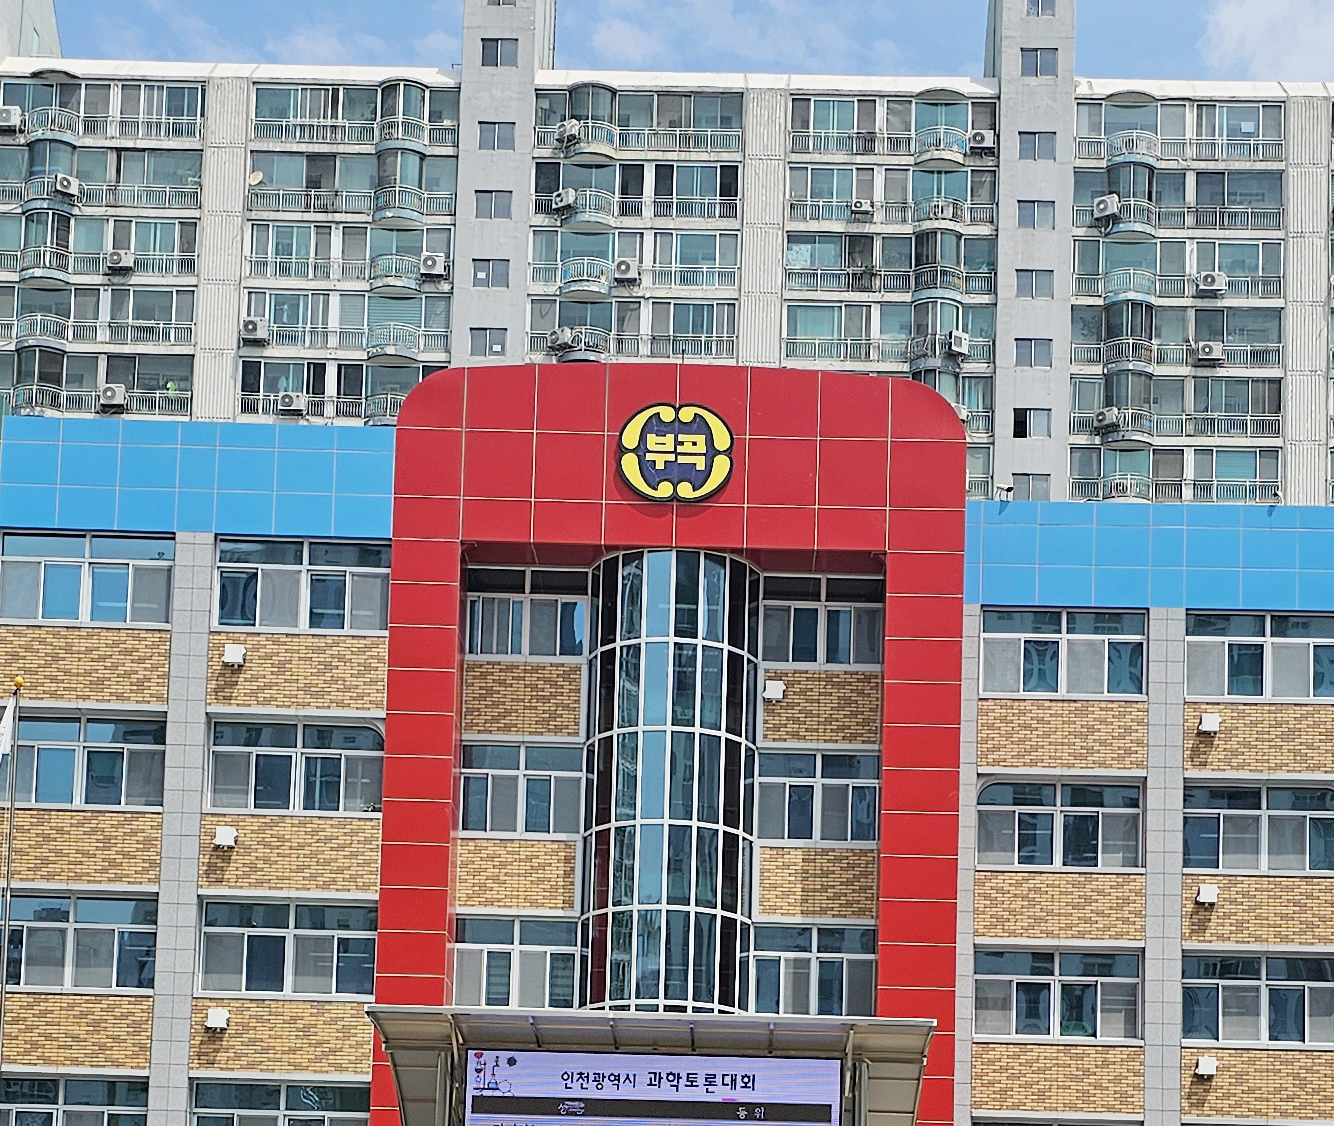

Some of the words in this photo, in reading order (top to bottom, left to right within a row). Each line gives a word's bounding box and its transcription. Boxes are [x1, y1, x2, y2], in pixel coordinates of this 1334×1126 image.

[645, 433, 707, 471] 부곡
[560, 1070, 637, 1091] 인천광역시
[646, 1070, 757, 1094] 과학토론대회
